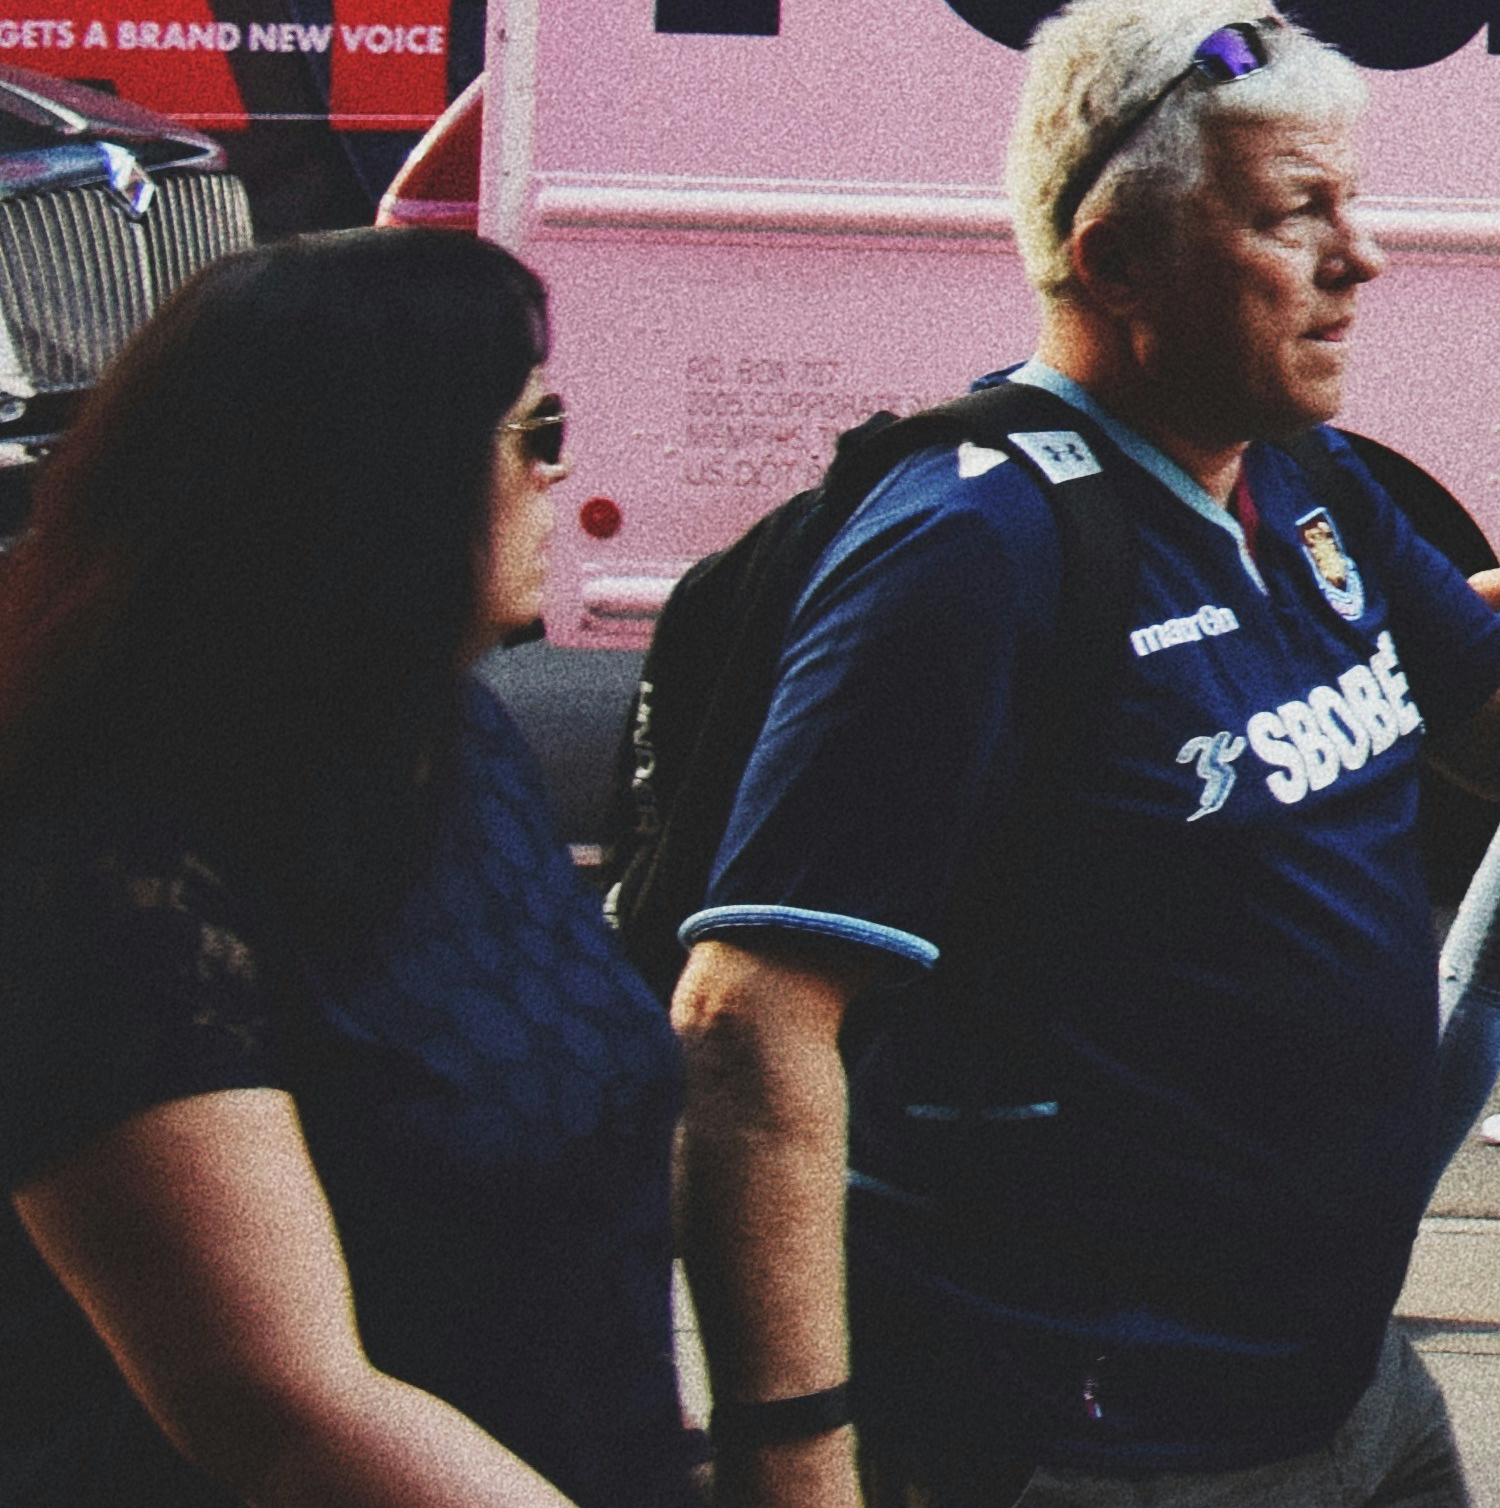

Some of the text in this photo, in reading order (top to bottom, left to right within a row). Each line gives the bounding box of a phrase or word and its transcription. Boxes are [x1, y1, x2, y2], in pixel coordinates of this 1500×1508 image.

[0, 21, 446, 56] GETS A BRAND NEW VOICE
[1246, 630, 1425, 805] SBOBE
